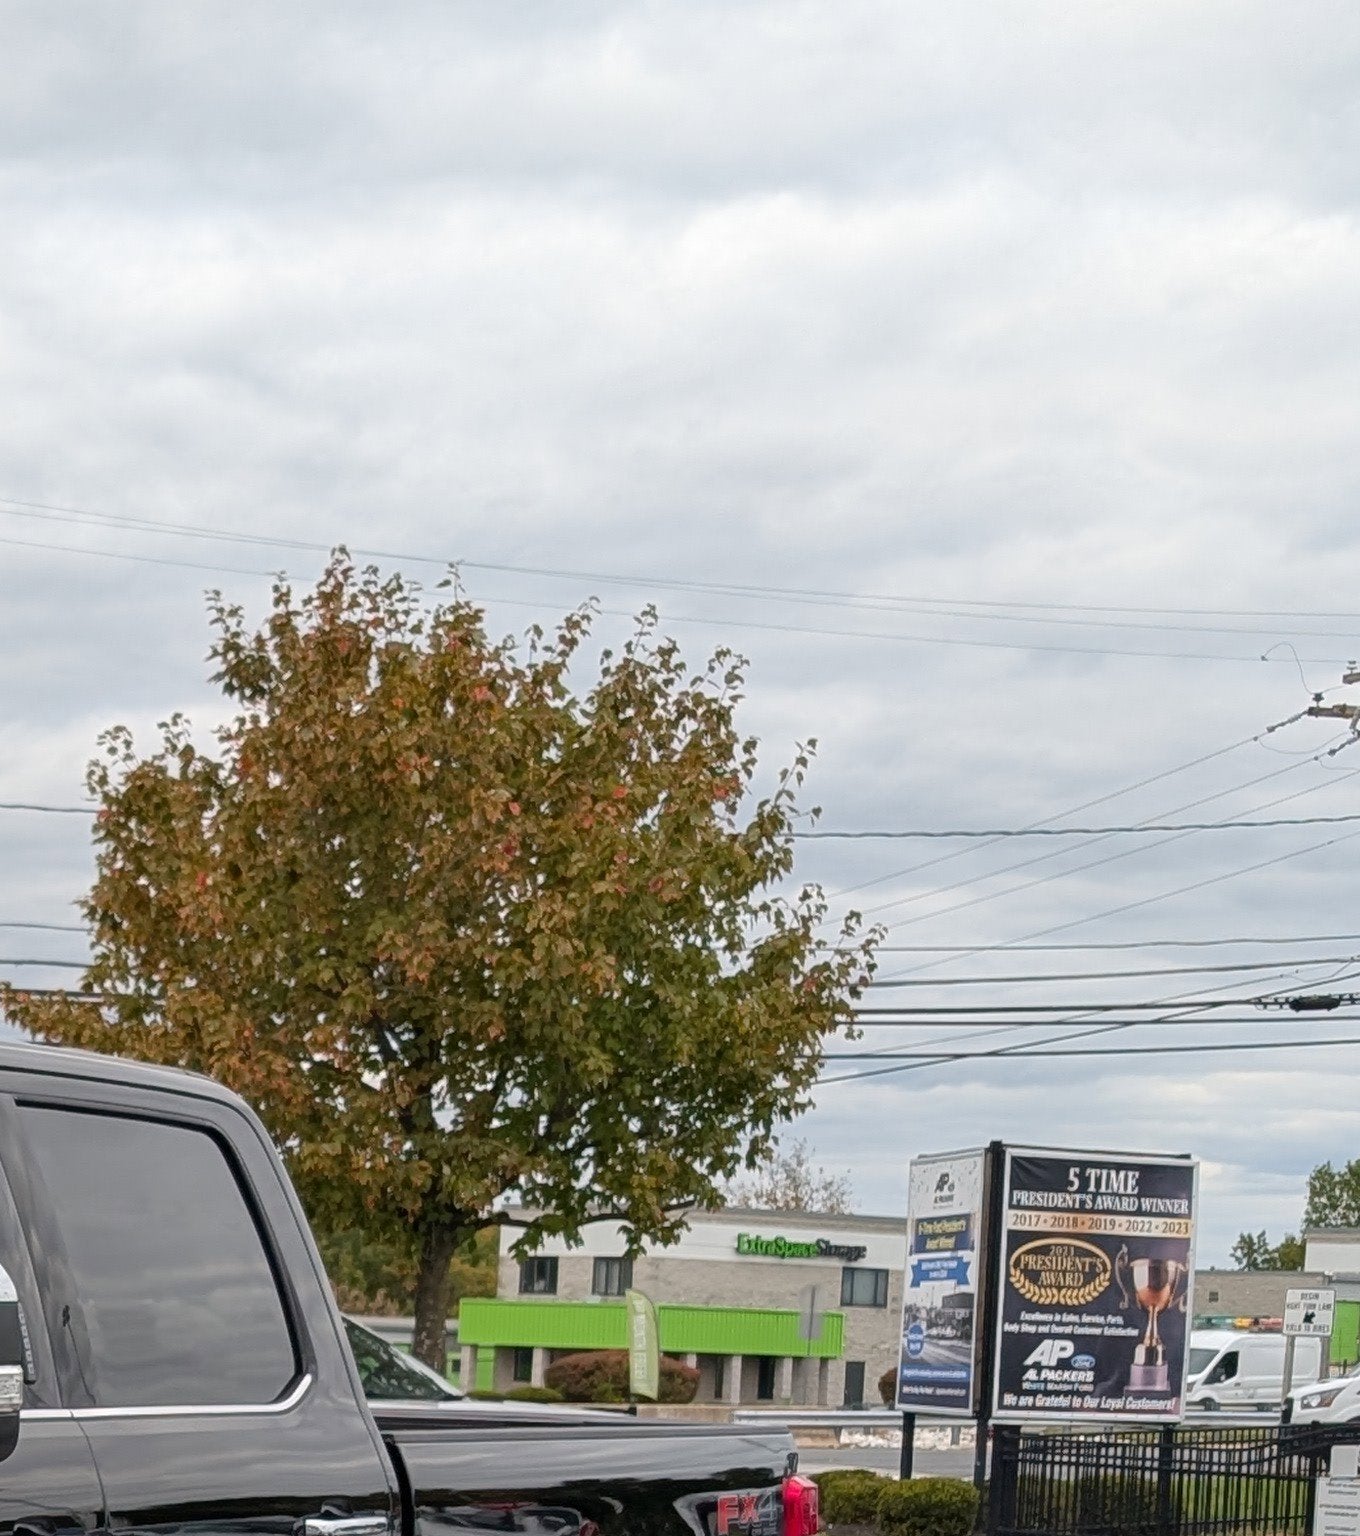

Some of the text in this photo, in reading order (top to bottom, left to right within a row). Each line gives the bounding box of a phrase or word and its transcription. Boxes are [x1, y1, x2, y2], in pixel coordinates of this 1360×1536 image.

[1066, 1166, 1140, 1194] 5 TIME
[1012, 1189, 1189, 1215] PRESIDENT'S AWARD WINNER
[1012, 1213, 1189, 1235] 2017 2018 2019 2022 2023
[1019, 1254, 1103, 1272] PRESIDENT'S
[1037, 1270, 1084, 1287] AWARD
[1022, 1339, 1075, 1367] AP
[1003, 1393, 1017, 1406] We
